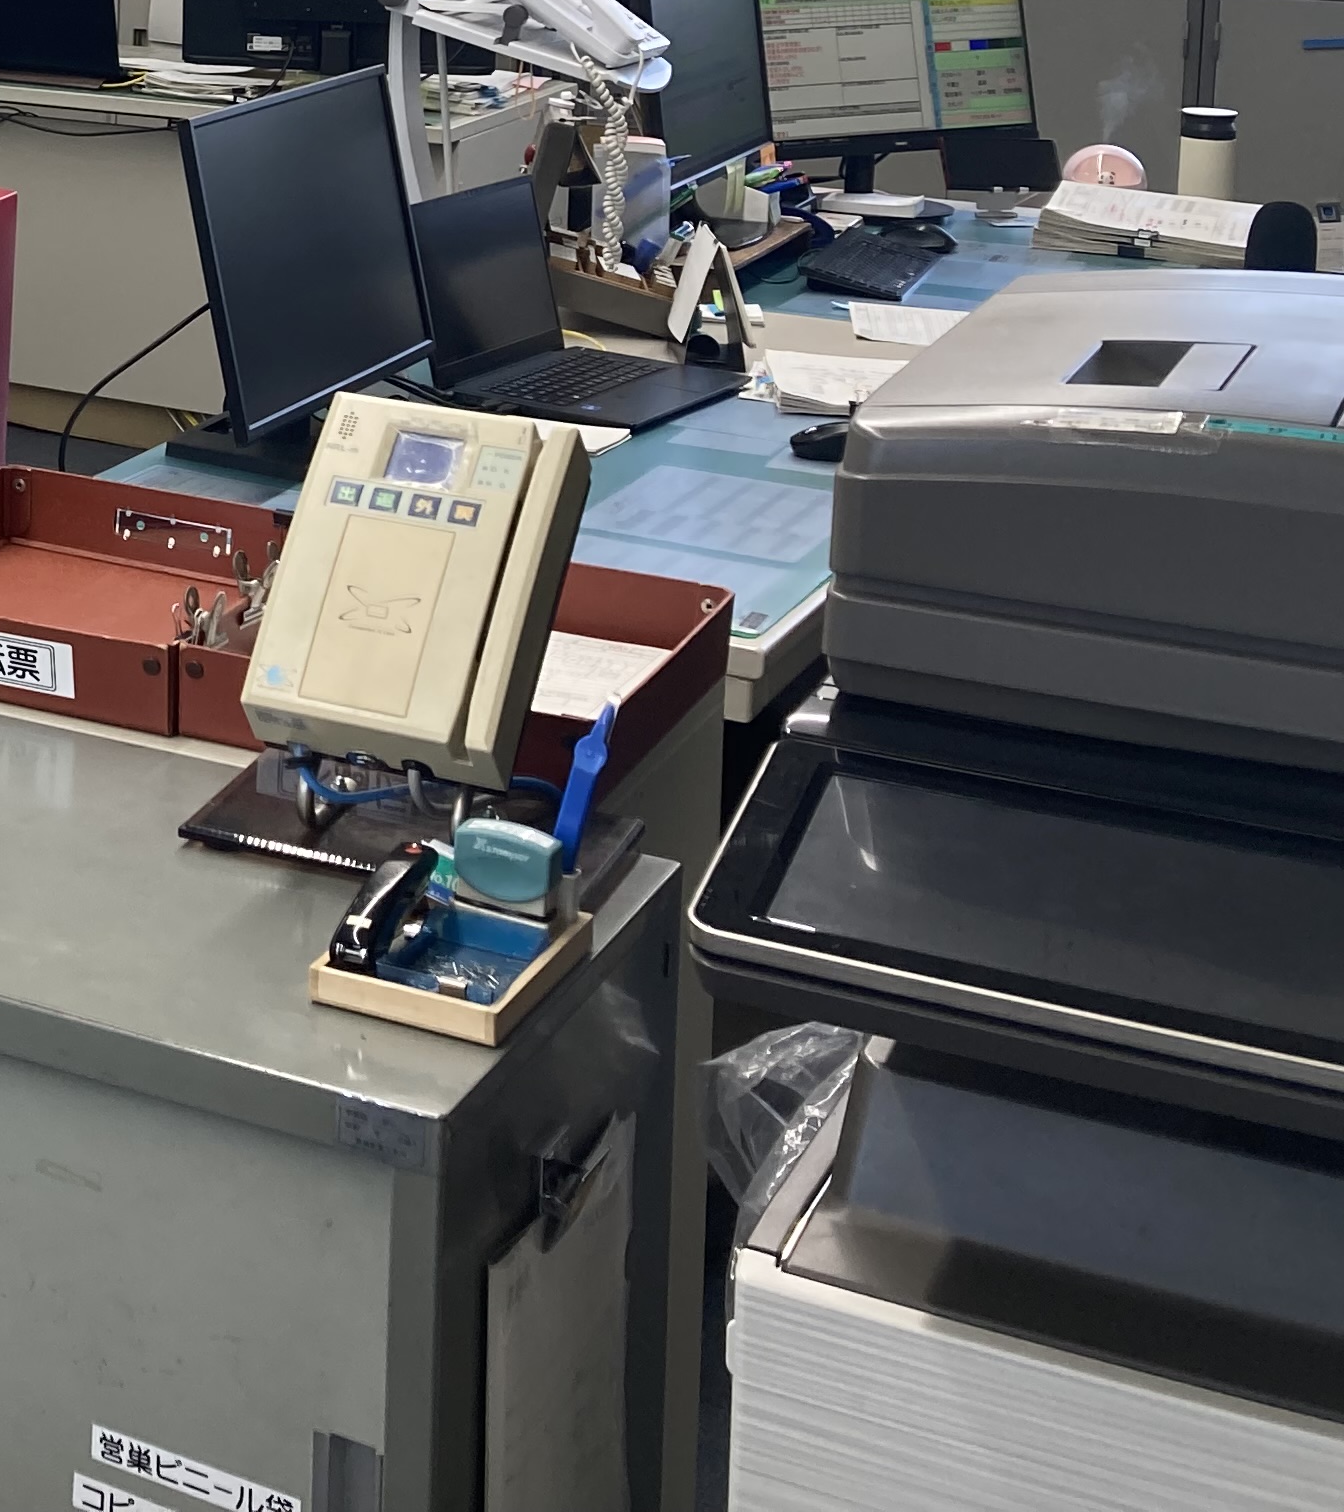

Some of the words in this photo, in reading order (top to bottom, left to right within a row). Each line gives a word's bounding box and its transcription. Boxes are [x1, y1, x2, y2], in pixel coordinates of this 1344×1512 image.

[415, 497, 433, 515] 外
[99, 1431, 294, 1512] 営巣ビニール袋
